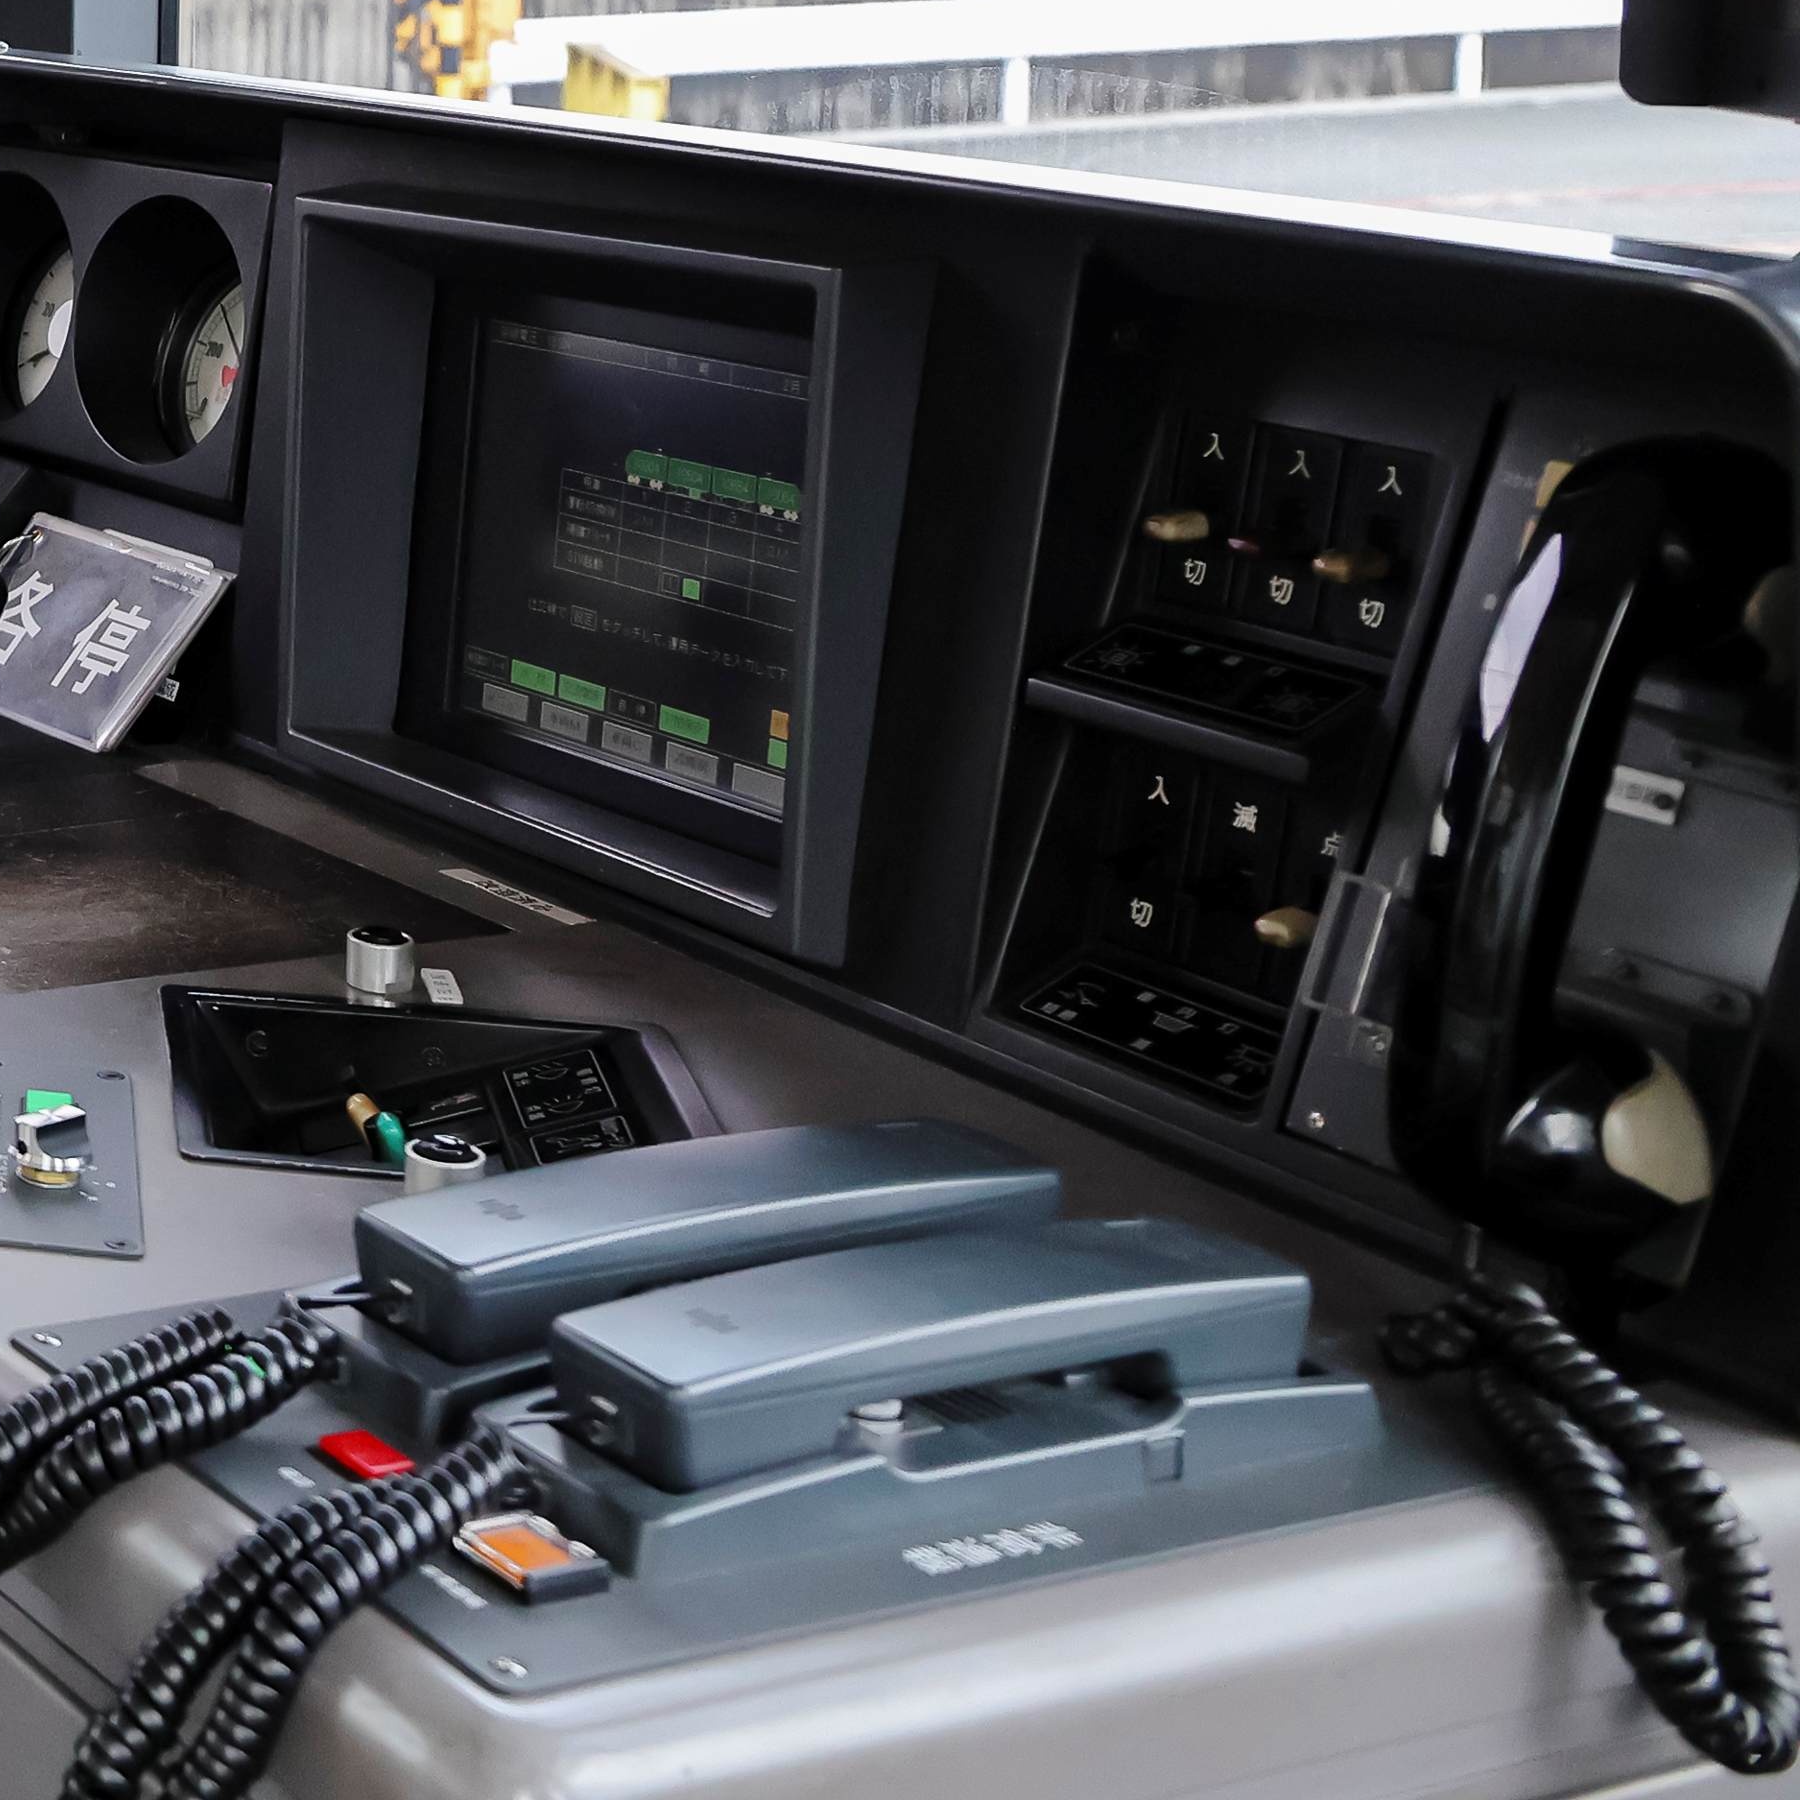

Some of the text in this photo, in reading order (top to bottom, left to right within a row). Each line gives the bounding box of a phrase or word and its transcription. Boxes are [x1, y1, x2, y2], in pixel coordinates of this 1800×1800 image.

[1203, 432, 1225, 461] 入
[1288, 449, 1311, 480] 入
[1377, 465, 1403, 496] 入
[1183, 558, 1207, 586] 切
[1269, 575, 1294, 606] 切
[1358, 598, 1385, 629] 切
[1147, 775, 1170, 805] 入
[1130, 897, 1153, 928] 切
